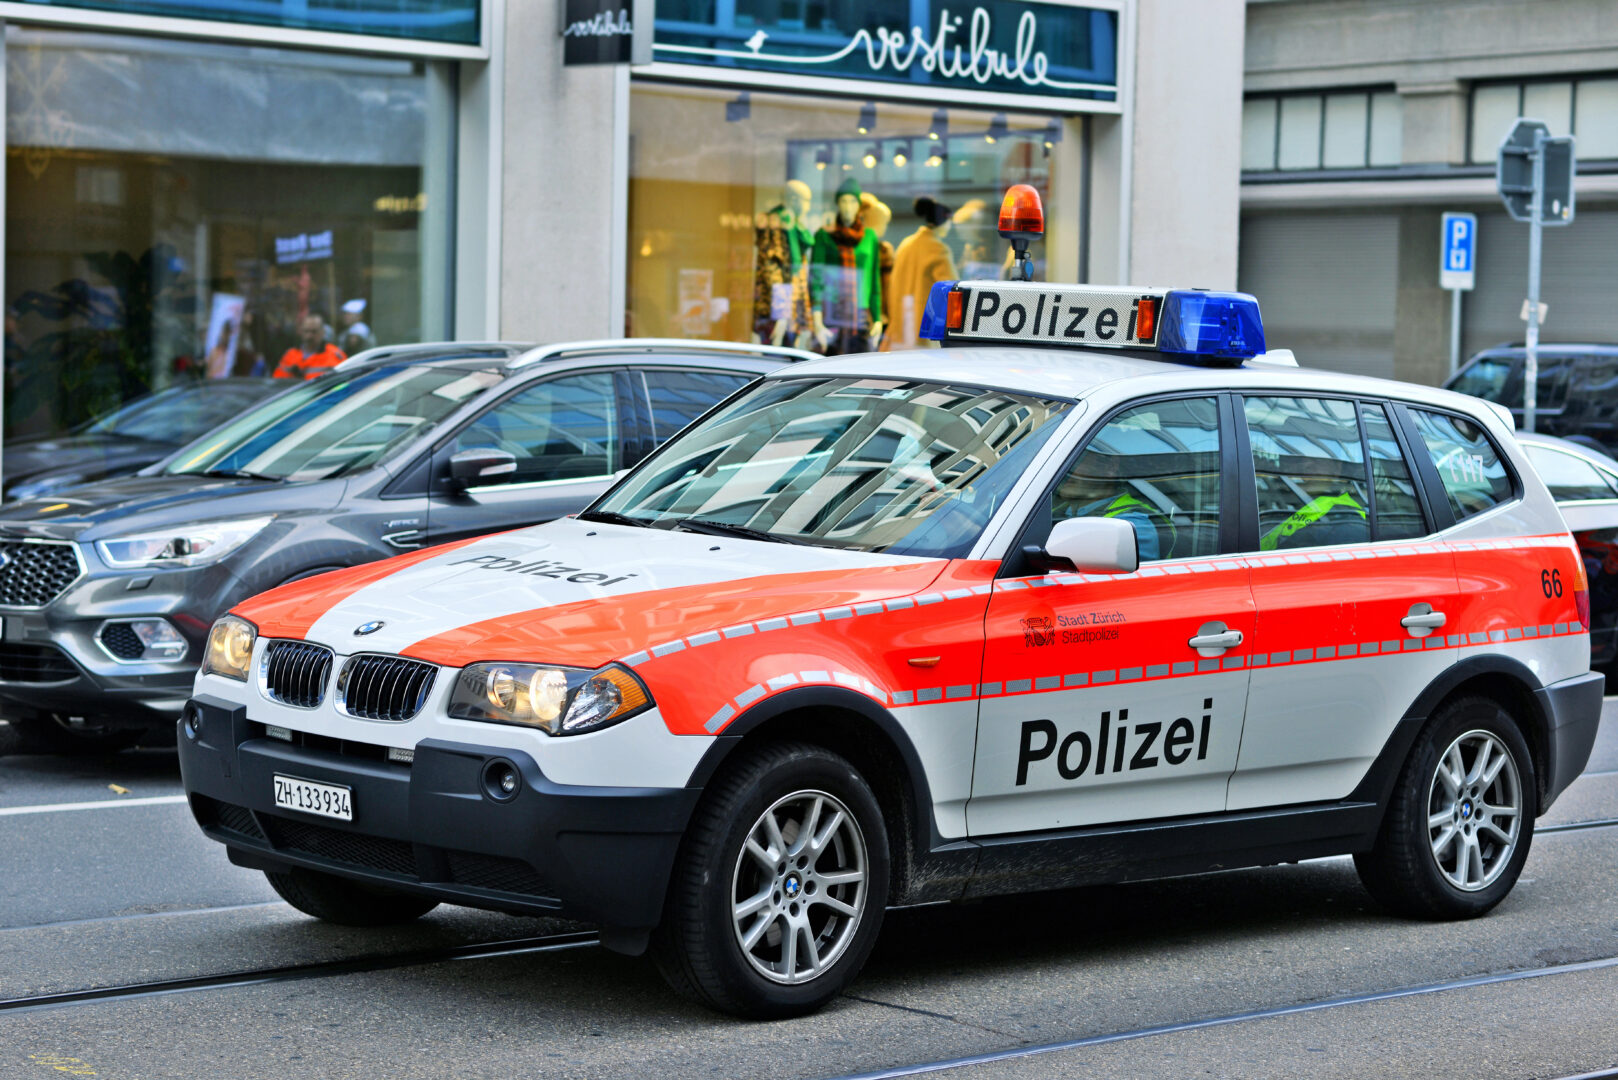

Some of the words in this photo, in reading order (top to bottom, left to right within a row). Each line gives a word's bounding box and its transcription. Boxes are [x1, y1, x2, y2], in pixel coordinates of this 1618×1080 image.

[1453, 221, 1467, 248] P
[971, 291, 1140, 341] Polizei
[446, 555, 639, 587] Polizei
[1541, 568, 1563, 599] 66
[1057, 614, 1090, 627] Stadt
[1090, 611, 1126, 624] Zürich
[1062, 626, 1120, 645] Stadtpolizei
[1015, 697, 1213, 786] Polizei
